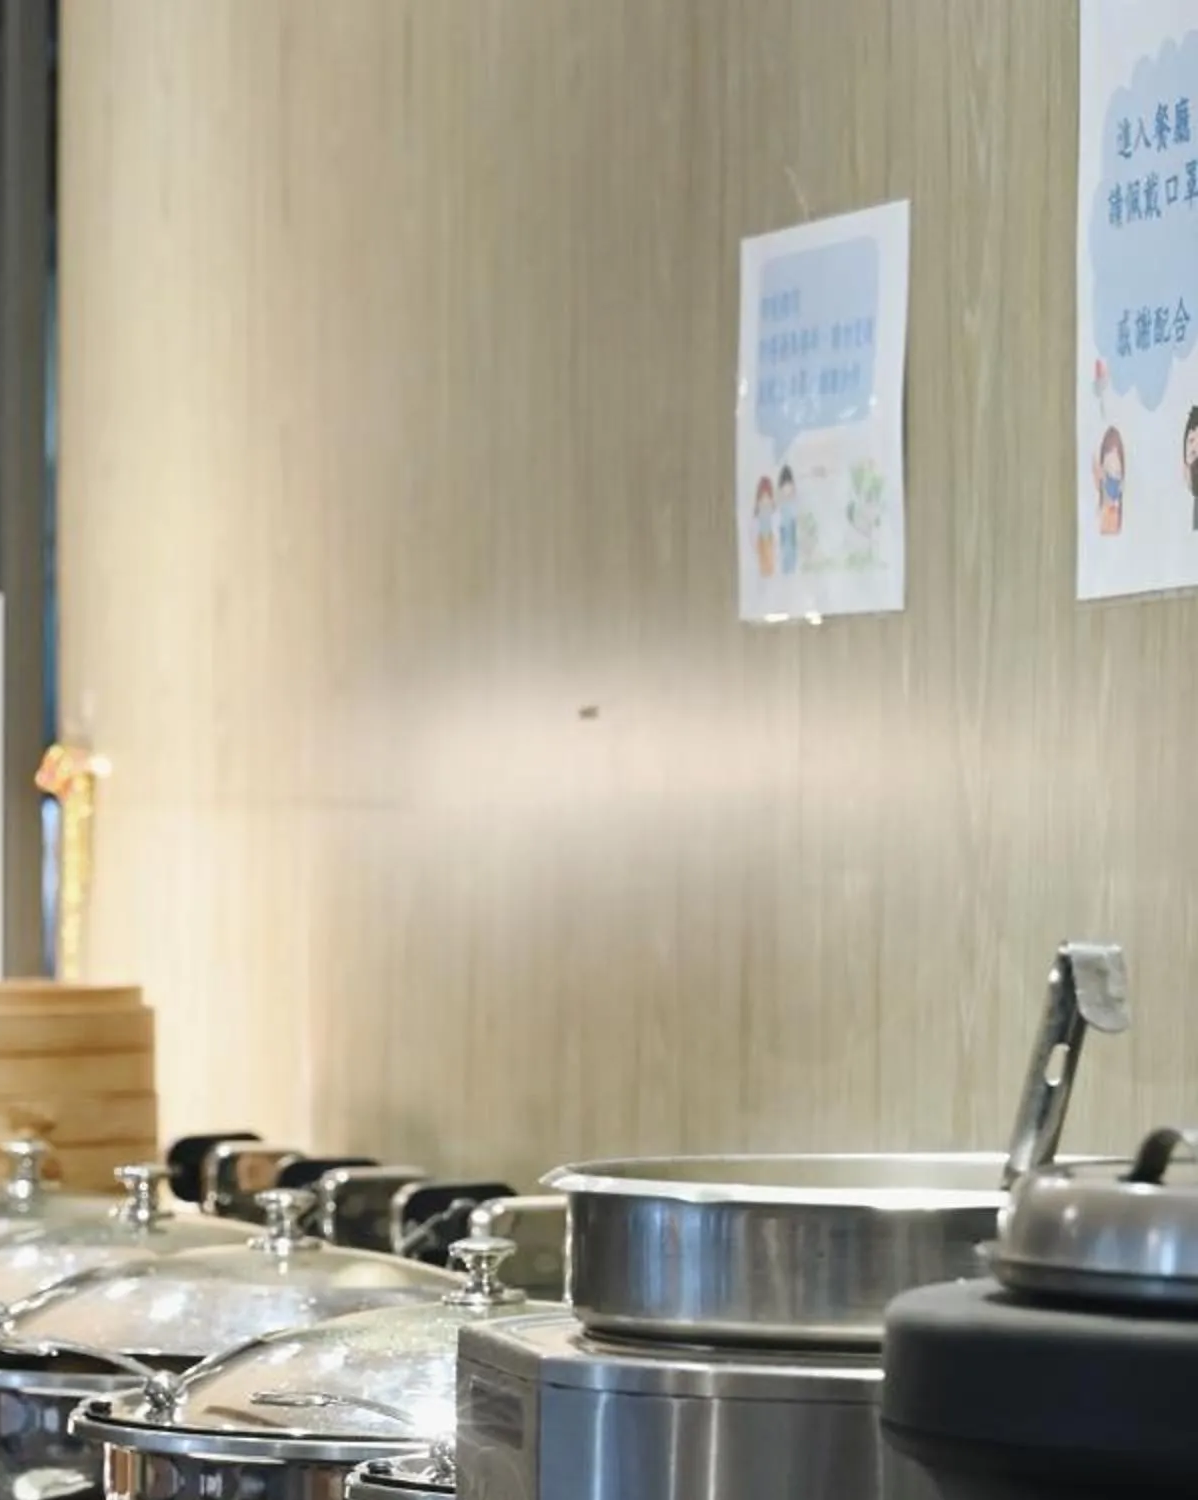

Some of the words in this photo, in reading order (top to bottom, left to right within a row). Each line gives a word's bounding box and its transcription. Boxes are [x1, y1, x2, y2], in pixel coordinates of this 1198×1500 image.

[1117, 97, 1190, 159] 進入餐廳
[1116, 296, 1190, 357] 感謝配合
